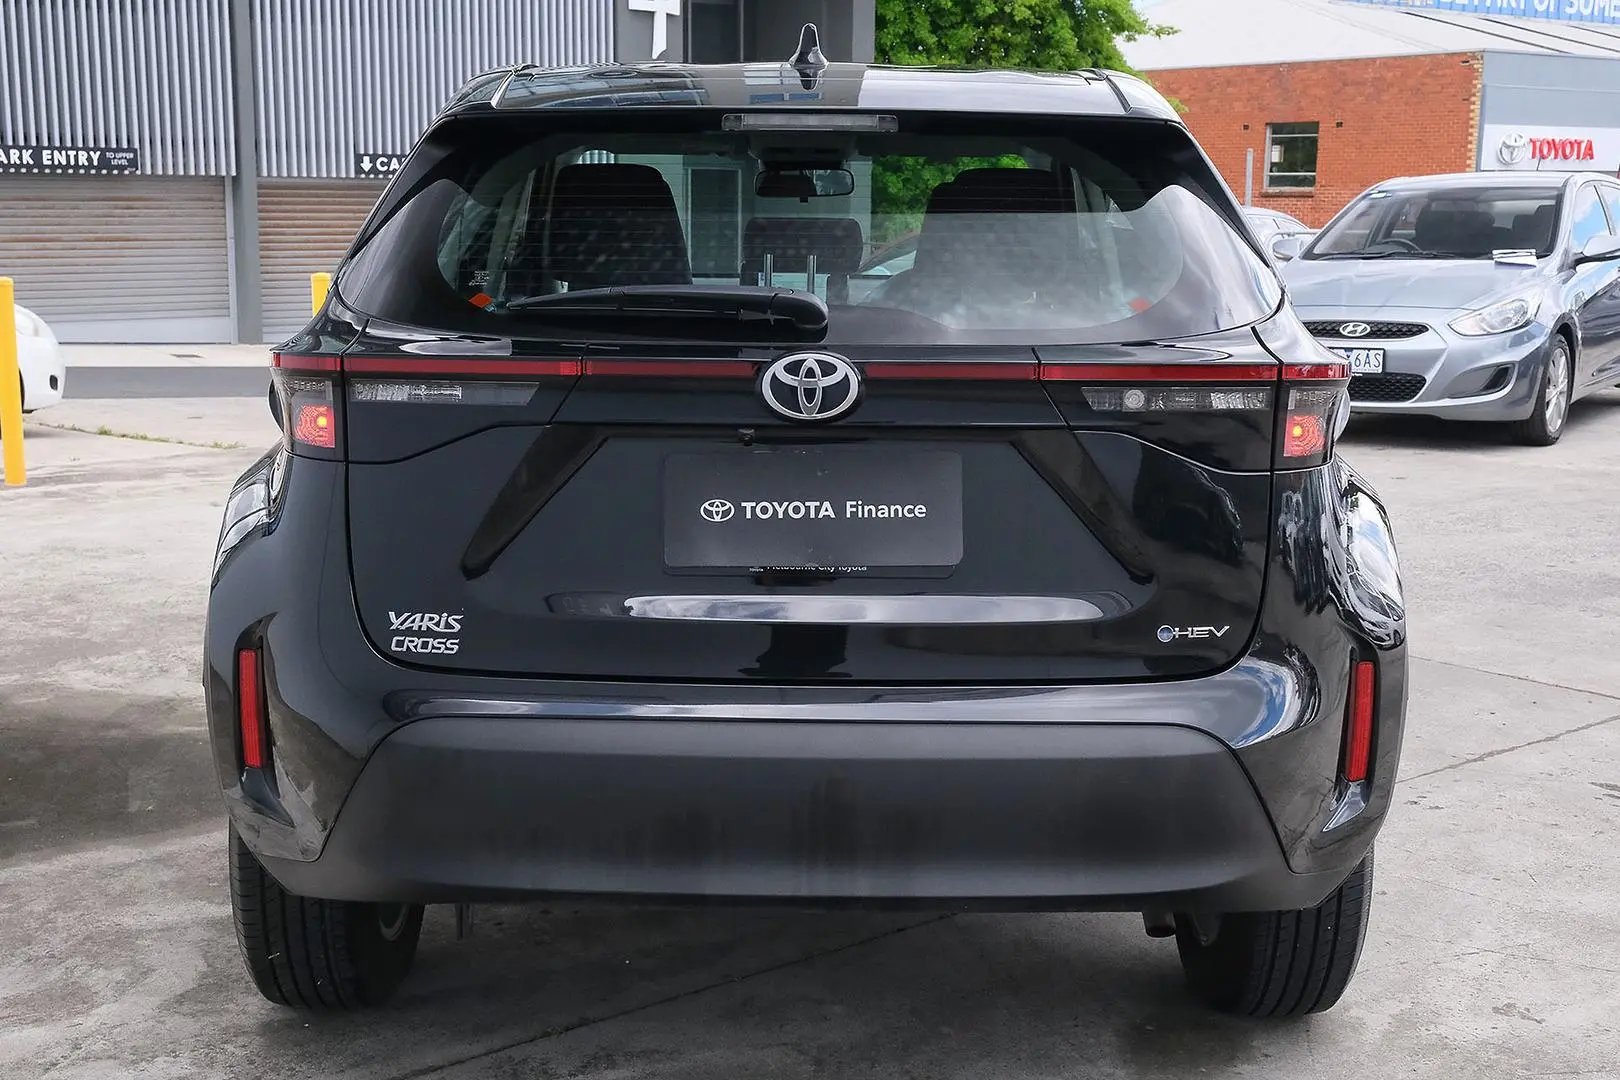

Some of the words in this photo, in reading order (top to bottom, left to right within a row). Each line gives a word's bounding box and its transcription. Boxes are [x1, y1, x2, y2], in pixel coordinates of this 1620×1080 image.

[42, 149, 101, 166] ENTRY
[1529, 138, 1595, 160] TOYOTA
[376, 156, 405, 171] CA
[1354, 352, 1381, 368] 6AS
[741, 501, 835, 519] TOYOTA
[845, 500, 927, 518] Finance
[391, 636, 460, 654] CROSS
